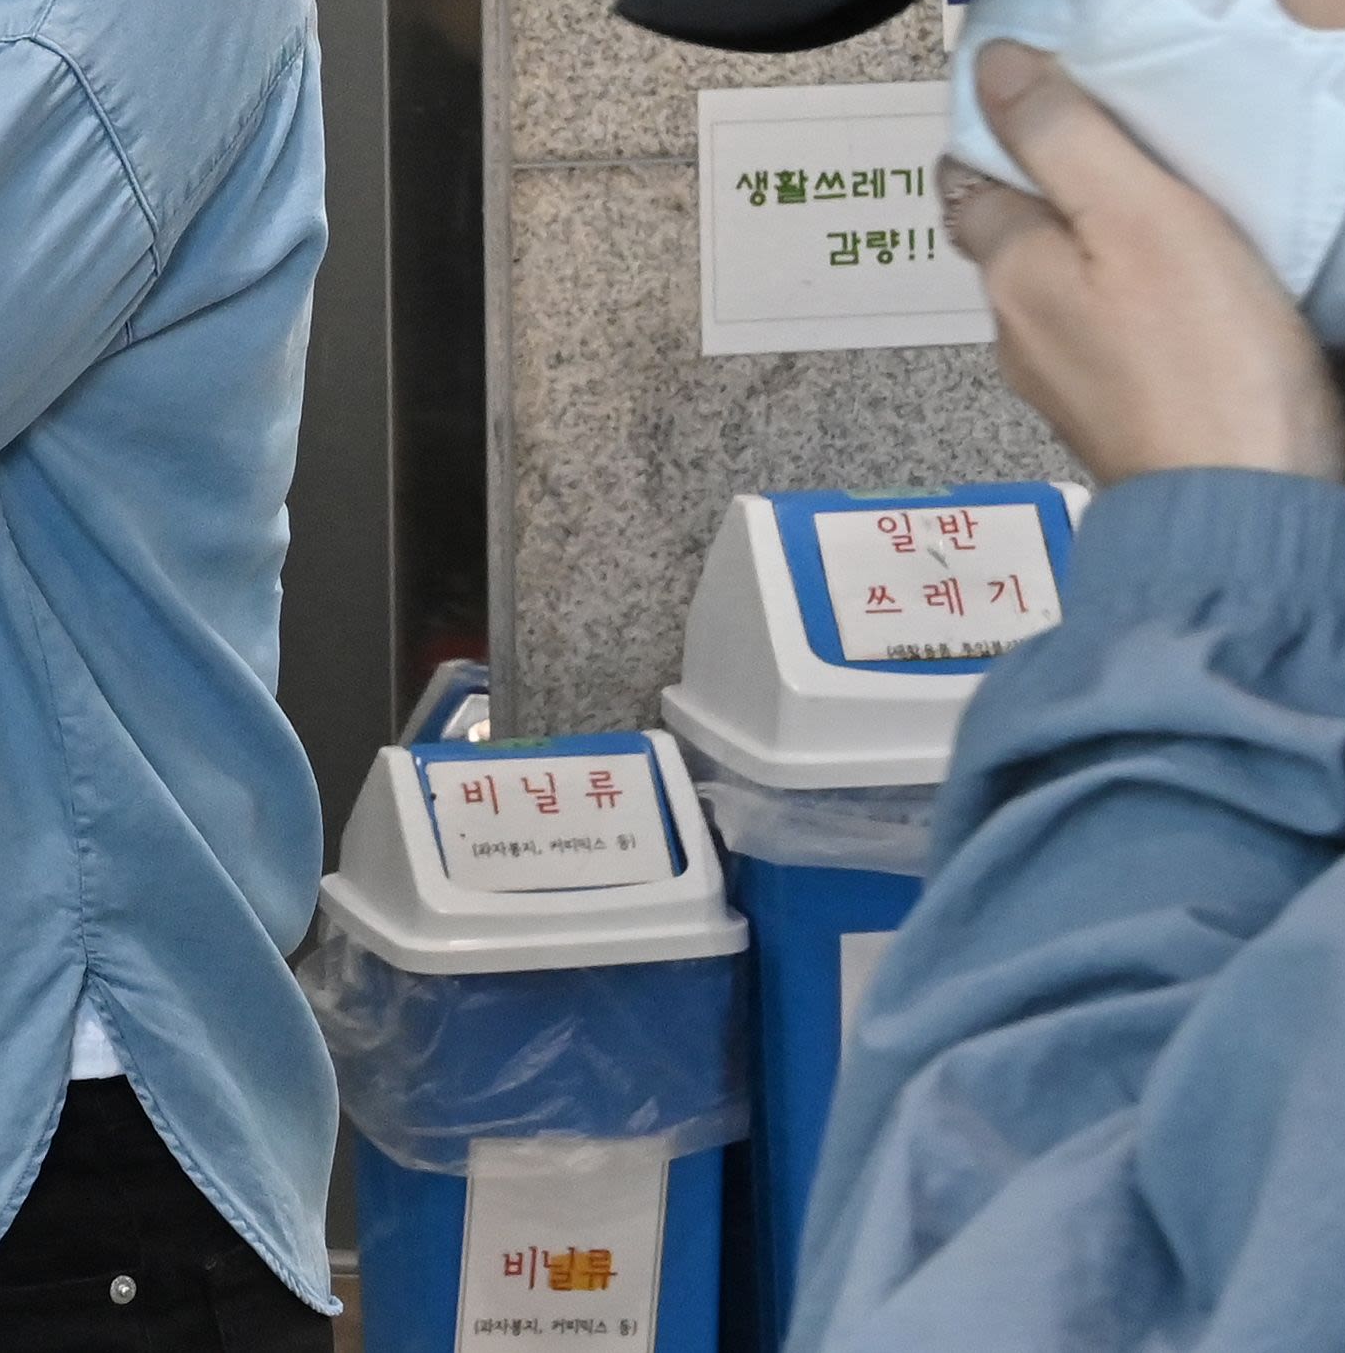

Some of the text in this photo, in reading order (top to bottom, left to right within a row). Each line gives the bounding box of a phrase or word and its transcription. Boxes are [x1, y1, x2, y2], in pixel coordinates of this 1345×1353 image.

[736, 166, 926, 208] 생활쓰레기
[826, 226, 937, 268] 감량!!
[502, 1245, 619, 1292] 비닐류
[550, 1318, 608, 1336] 커피믹스
